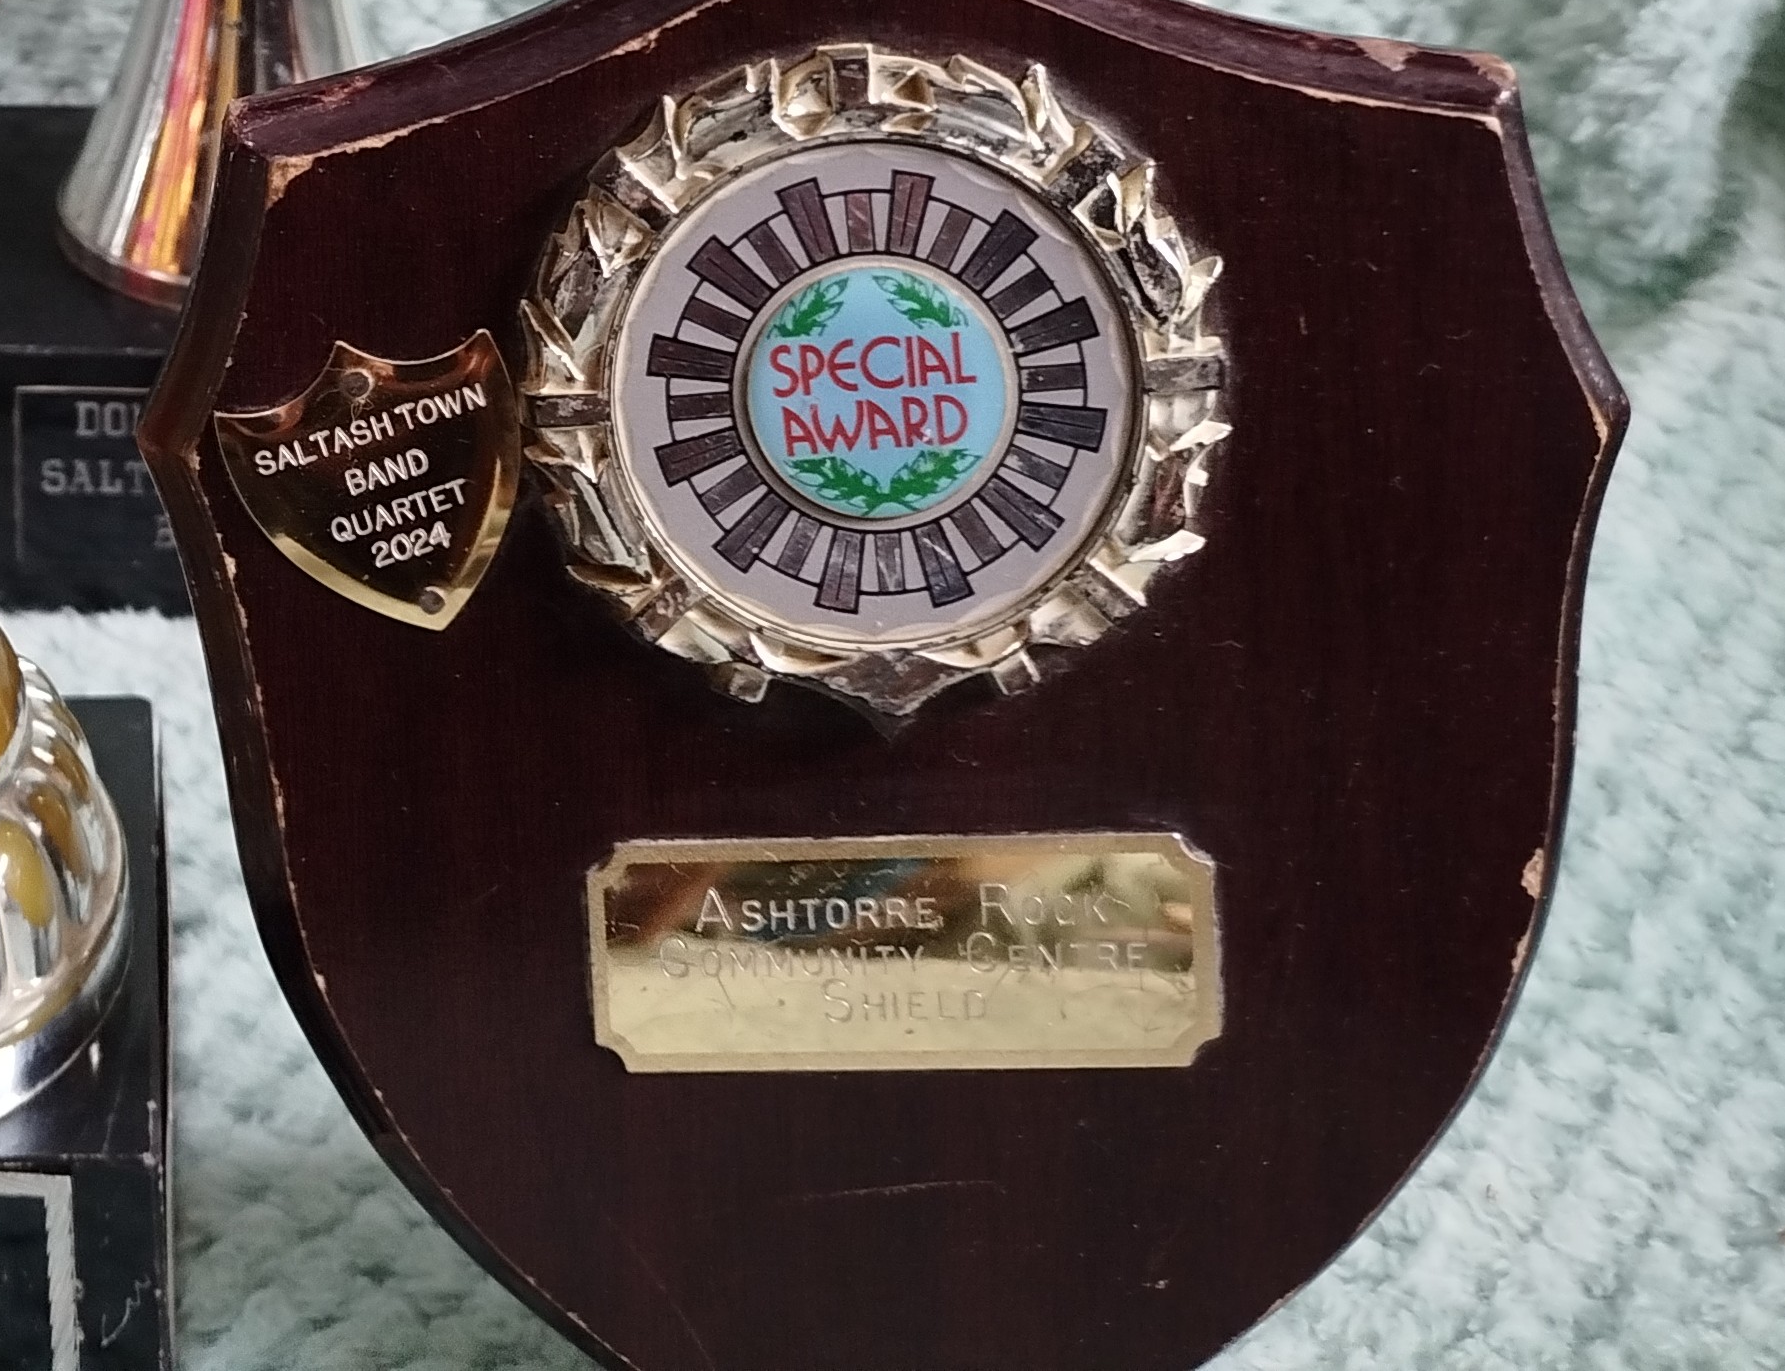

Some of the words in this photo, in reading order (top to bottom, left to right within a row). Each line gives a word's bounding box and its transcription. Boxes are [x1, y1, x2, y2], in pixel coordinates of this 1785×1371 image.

[769, 331, 977, 398] SPECIAL
[254, 412, 394, 476] SALTASH
[394, 383, 488, 430] TOWN
[781, 394, 969, 457] AWARD
[344, 448, 430, 497] BAND
[331, 478, 466, 543] QUARTET
[371, 521, 452, 569] 2024
